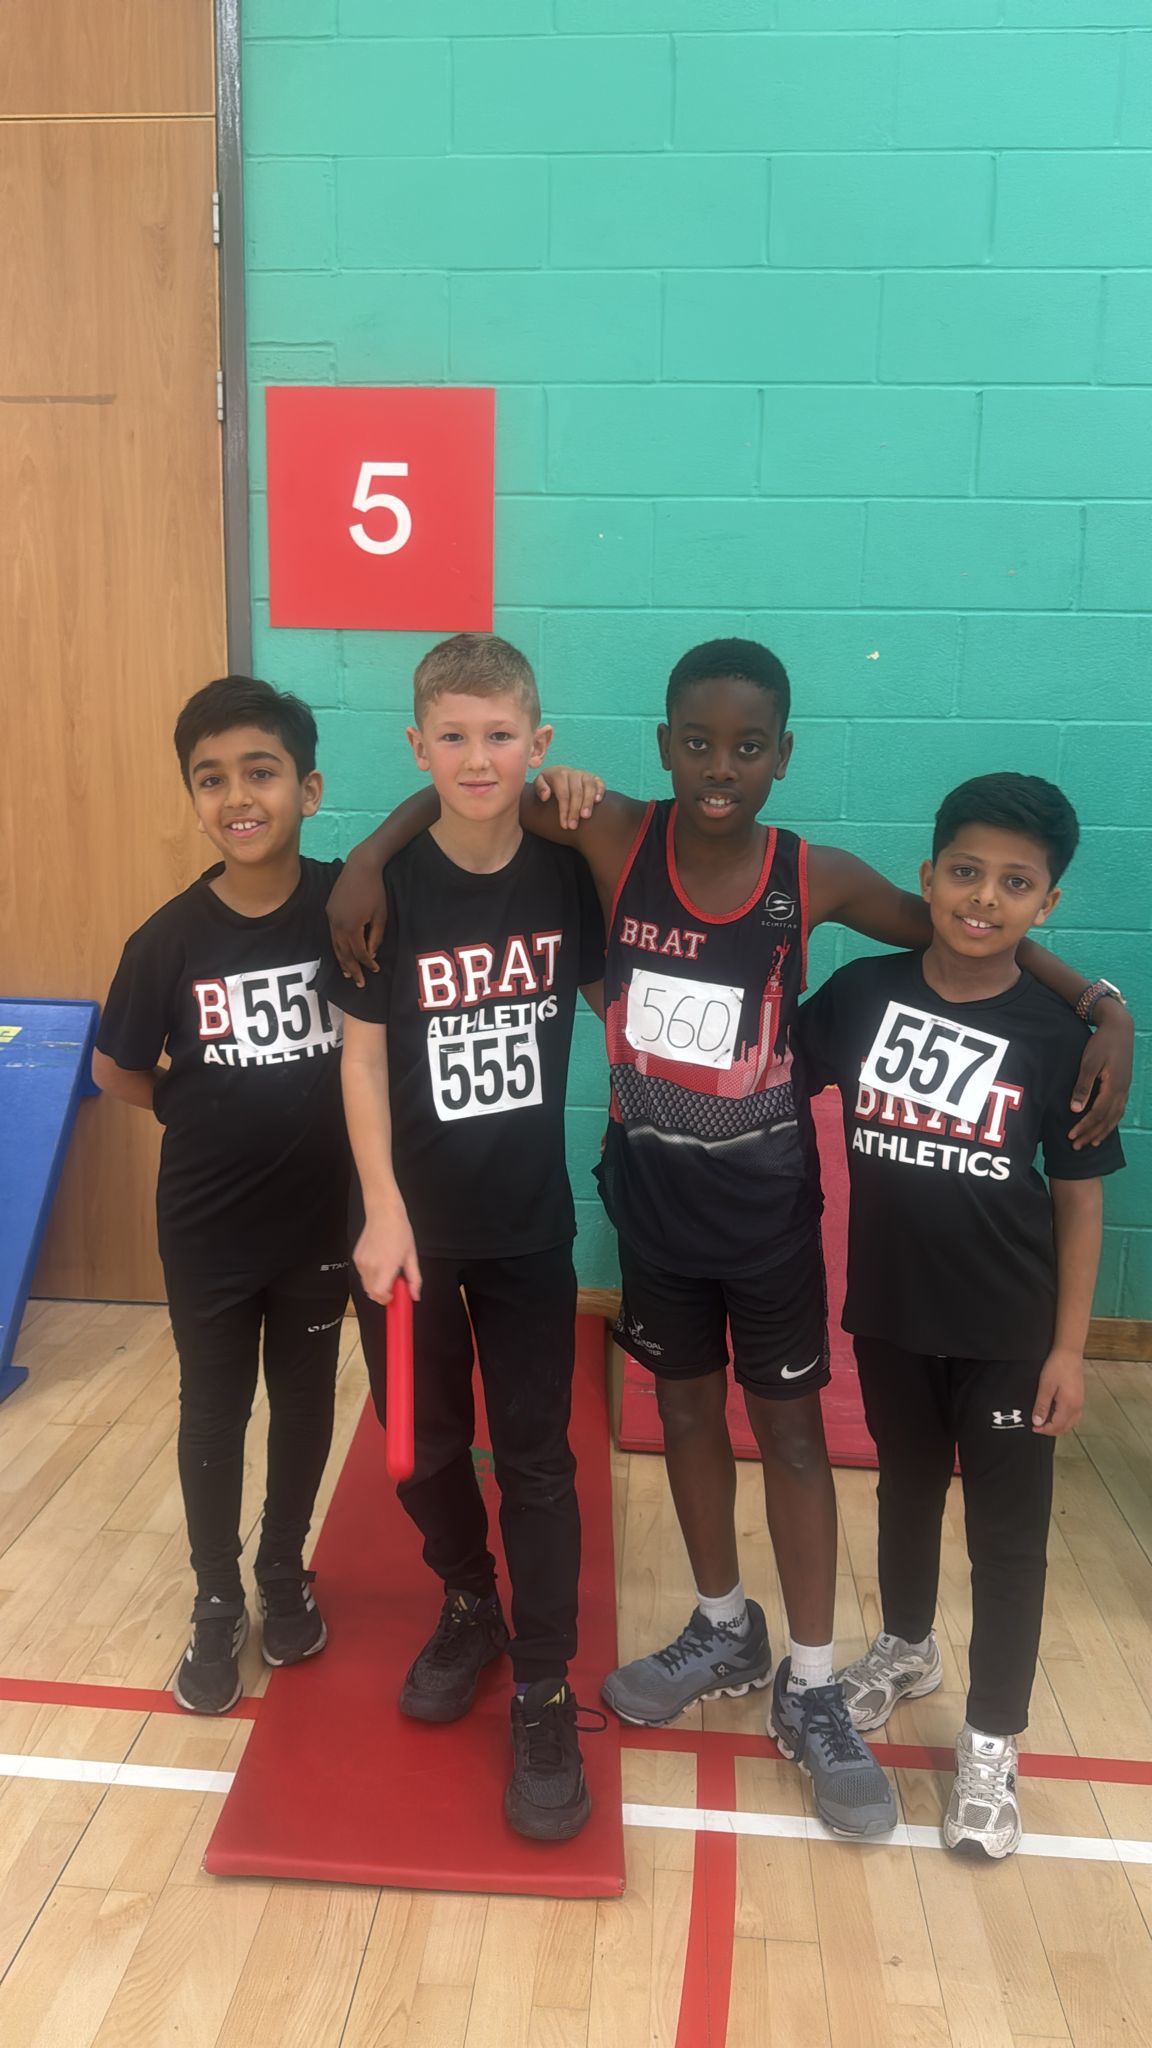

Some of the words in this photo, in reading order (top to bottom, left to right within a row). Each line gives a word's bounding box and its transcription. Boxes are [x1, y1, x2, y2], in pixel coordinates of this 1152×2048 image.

[349, 461, 412, 555] 5
[415, 929, 563, 1012] BRAT
[619, 915, 708, 960] BRAT
[640, 987, 731, 1052] 560
[438, 1032, 535, 1110] 555
[874, 1012, 997, 1106] 557
[852, 1127, 1011, 1181] ATHLETICS
